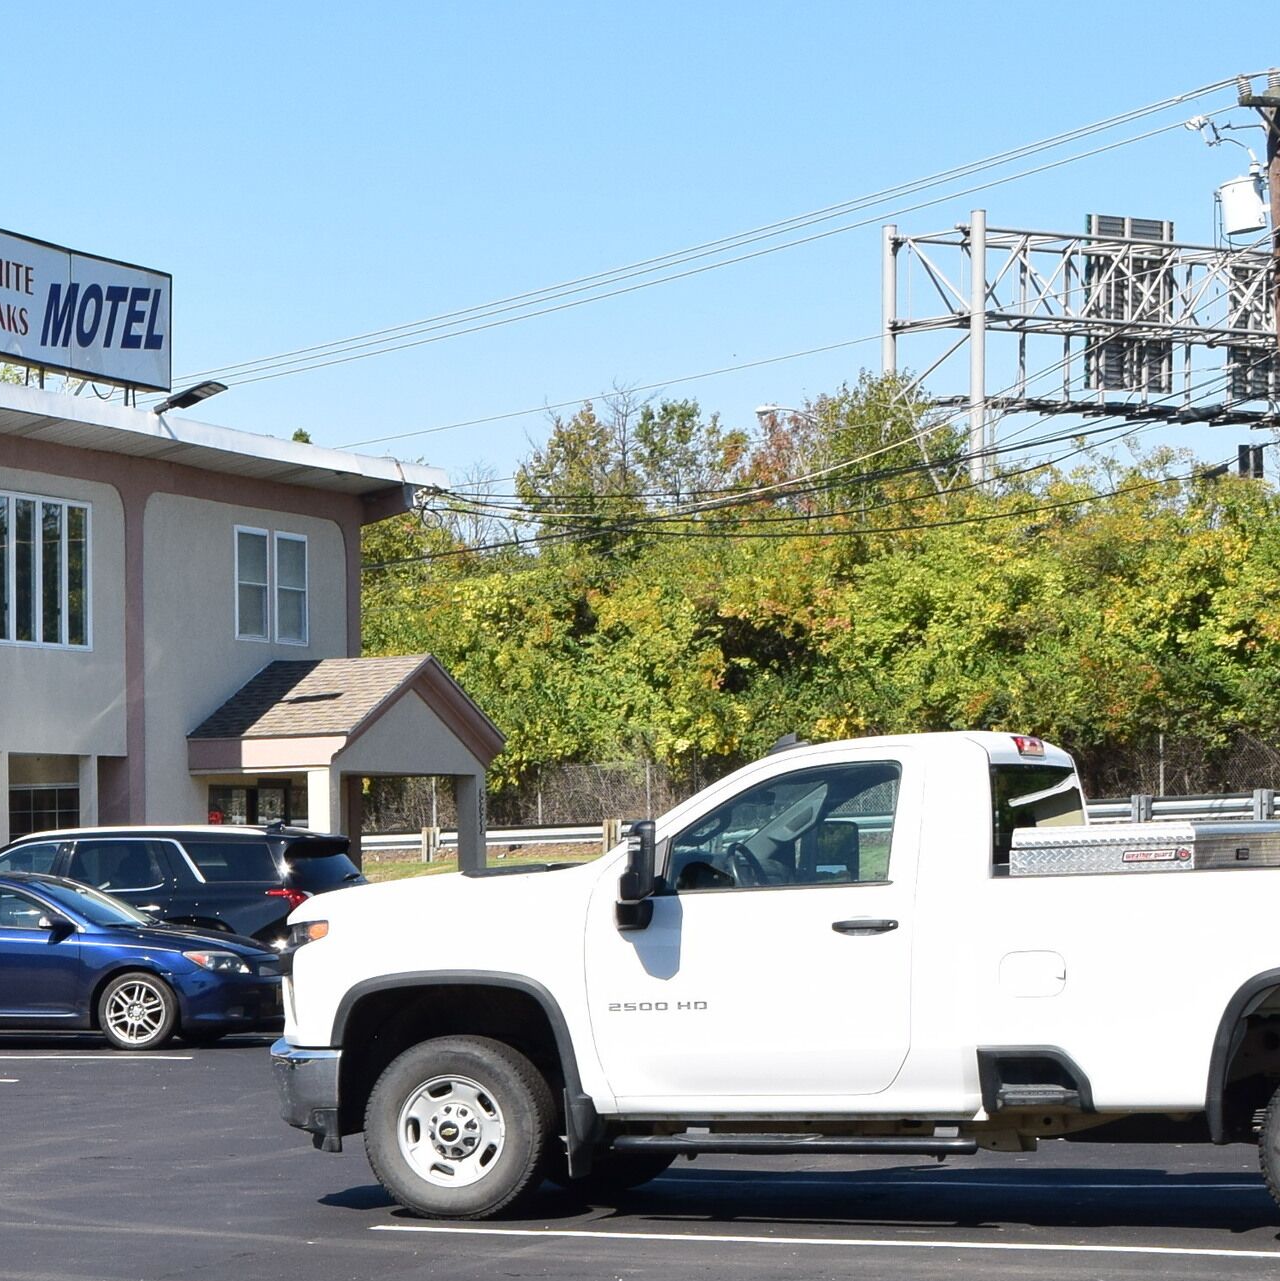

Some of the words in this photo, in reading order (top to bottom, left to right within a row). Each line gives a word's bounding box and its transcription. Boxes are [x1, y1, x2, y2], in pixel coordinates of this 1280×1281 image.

[40, 283, 164, 350] MOTEL
[608, 1002, 669, 1011] 2500
[677, 1001, 708, 1010] HD
